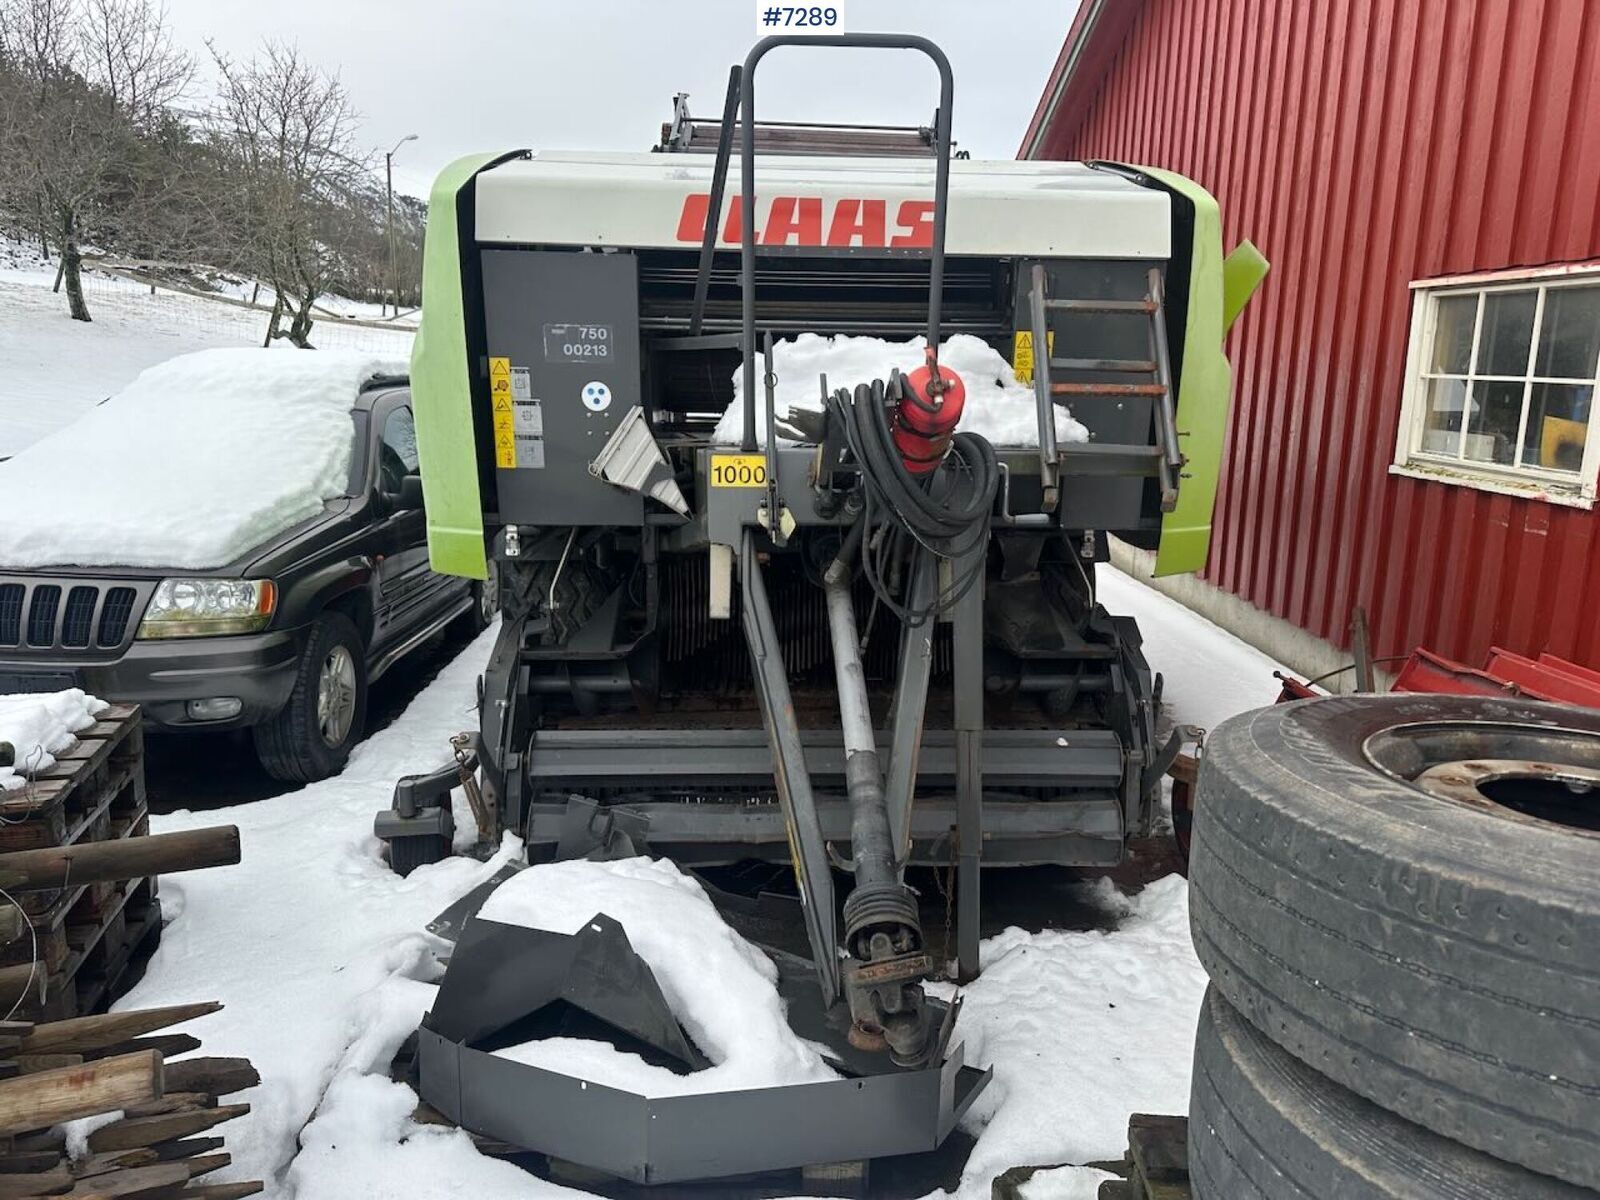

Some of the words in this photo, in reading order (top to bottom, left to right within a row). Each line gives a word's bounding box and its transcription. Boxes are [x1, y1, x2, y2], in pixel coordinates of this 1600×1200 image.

[676, 194, 936, 248] CLAAS
[579, 328, 607, 340] 750
[563, 343, 607, 356] 00213
[713, 465, 766, 483] 1000
